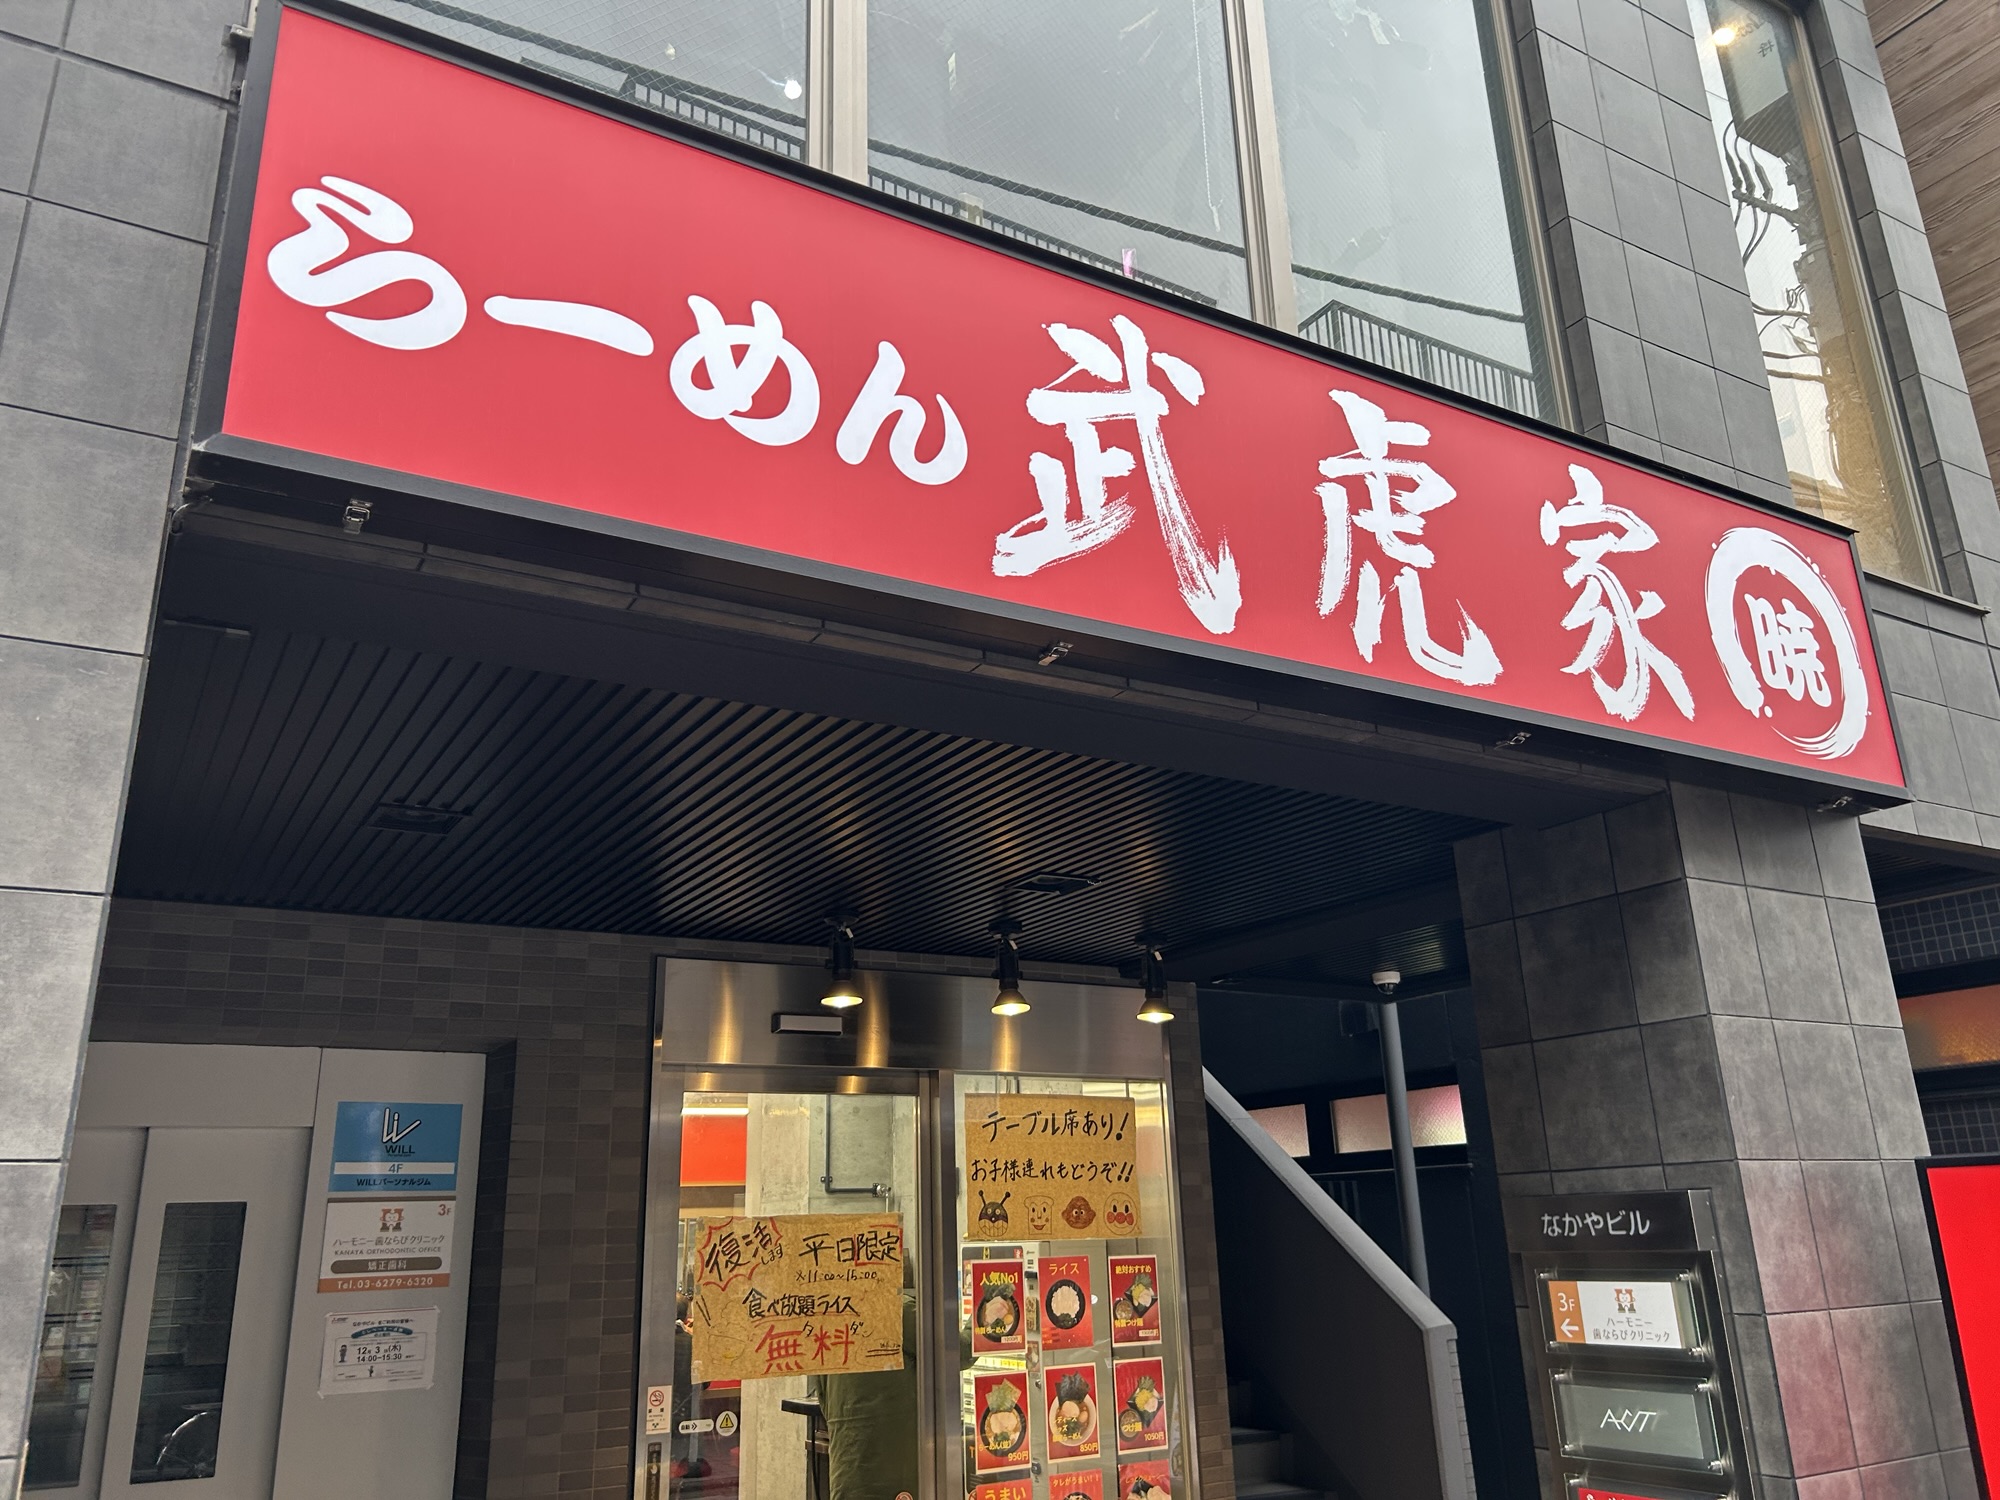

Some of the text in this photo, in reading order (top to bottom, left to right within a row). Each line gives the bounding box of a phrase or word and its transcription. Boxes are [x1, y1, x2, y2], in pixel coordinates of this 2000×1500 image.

[267, 175, 1833, 723] らーめん 武虎家 暁
[981, 1108, 1130, 1143] テーブル席あり!
[384, 1144, 416, 1154] WILL
[387, 1163, 404, 1174] 4F
[970, 1157, 1134, 1184] お子様連れもどうぞ!!
[356, 1177, 432, 1187] WILLパーソナルジム
[437, 1203, 453, 1217] 3F
[1540, 1209, 1651, 1238] なかやビル
[332, 1234, 446, 1247] ハーモニー歯ならびクリニック
[366, 1246, 416, 1255] ORTHODONTIC
[418, 1245, 441, 1253] OFFICE
[367, 1259, 407, 1271] 矯正歯科
[1048, 1262, 1080, 1276] ライス
[336, 1276, 434, 1289] Tel.03-6279-6320
[741, 1287, 861, 1319] 食べ放題ライス
[1557, 1292, 1576, 1312] 3F
[1606, 1316, 1653, 1328] ハーモニー
[1592, 1328, 1670, 1343] 歯ならびクリニック
[754, 1323, 856, 1376] 無料
[1144, 1431, 1165, 1442] 1050円
[1079, 1442, 1099, 1453] 850円
[1007, 1450, 1029, 1462] 950円
